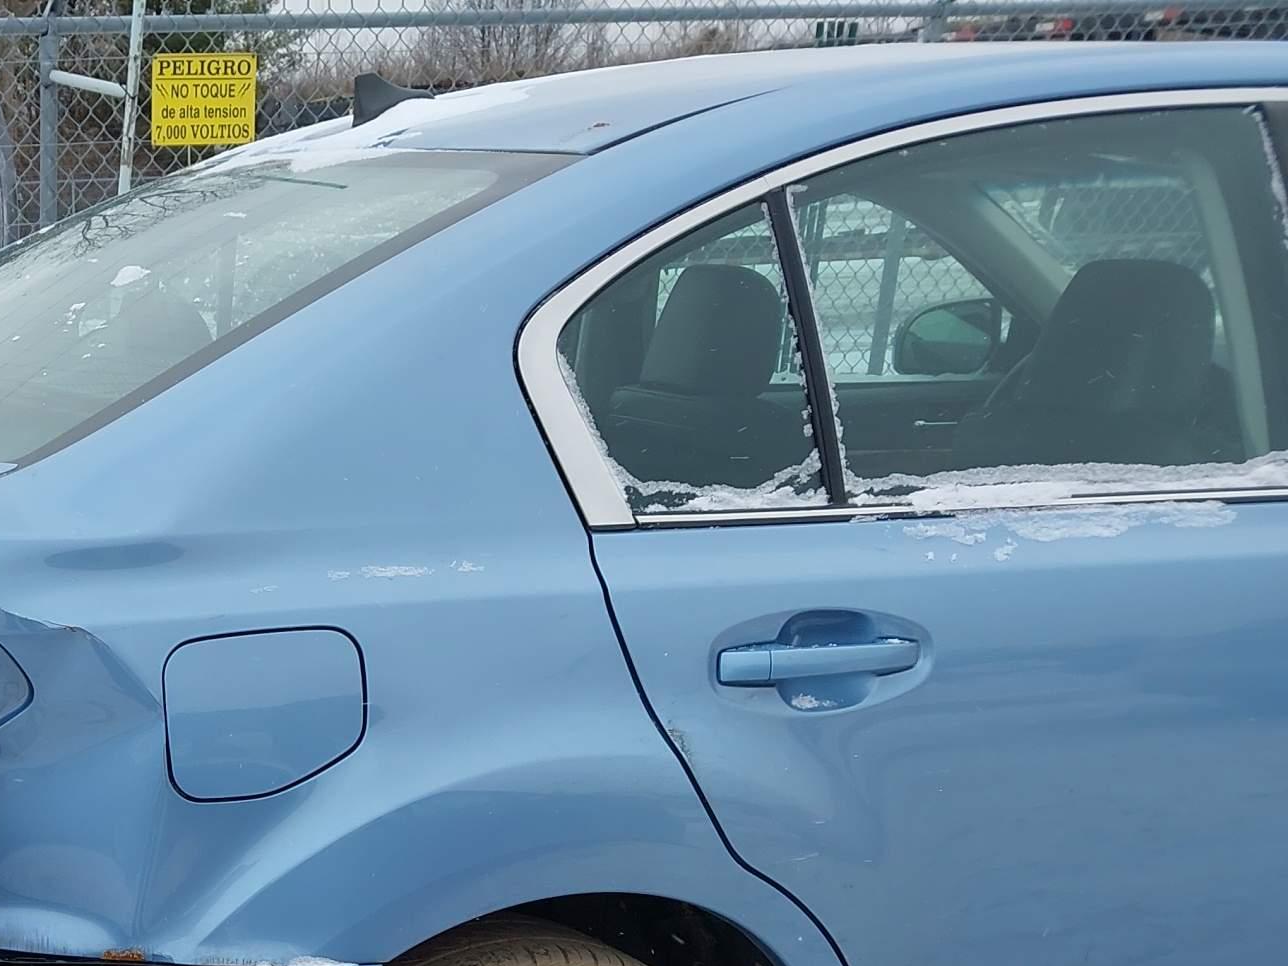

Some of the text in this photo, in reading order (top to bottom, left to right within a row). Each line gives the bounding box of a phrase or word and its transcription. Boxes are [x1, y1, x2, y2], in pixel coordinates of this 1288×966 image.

[158, 60, 251, 76] PELIGRO
[171, 83, 236, 98] NO TOQUE
[161, 104, 246, 119] de alta tension
[156, 124, 250, 142] 7,000 VOLTIOS
